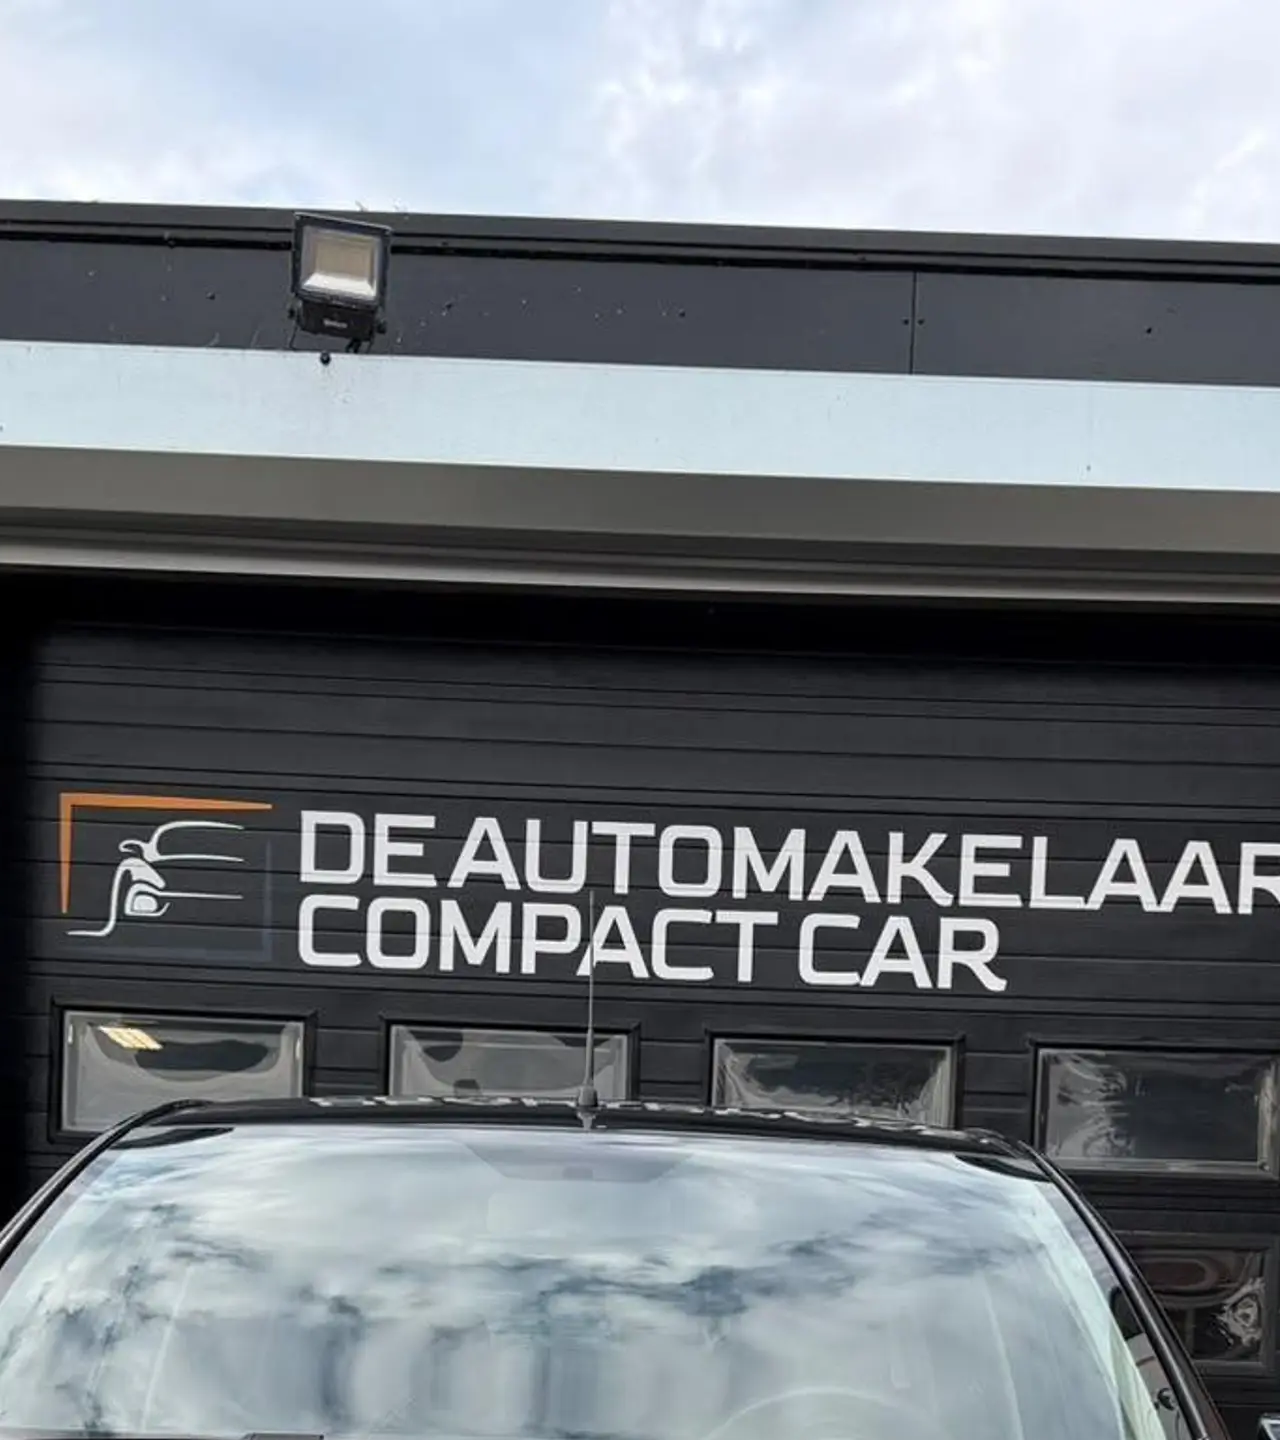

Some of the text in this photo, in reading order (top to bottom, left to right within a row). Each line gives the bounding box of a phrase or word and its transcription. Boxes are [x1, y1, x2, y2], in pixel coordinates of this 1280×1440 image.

[298, 810, 439, 889] DE
[297, 895, 1007, 993] COMPACT CAR
